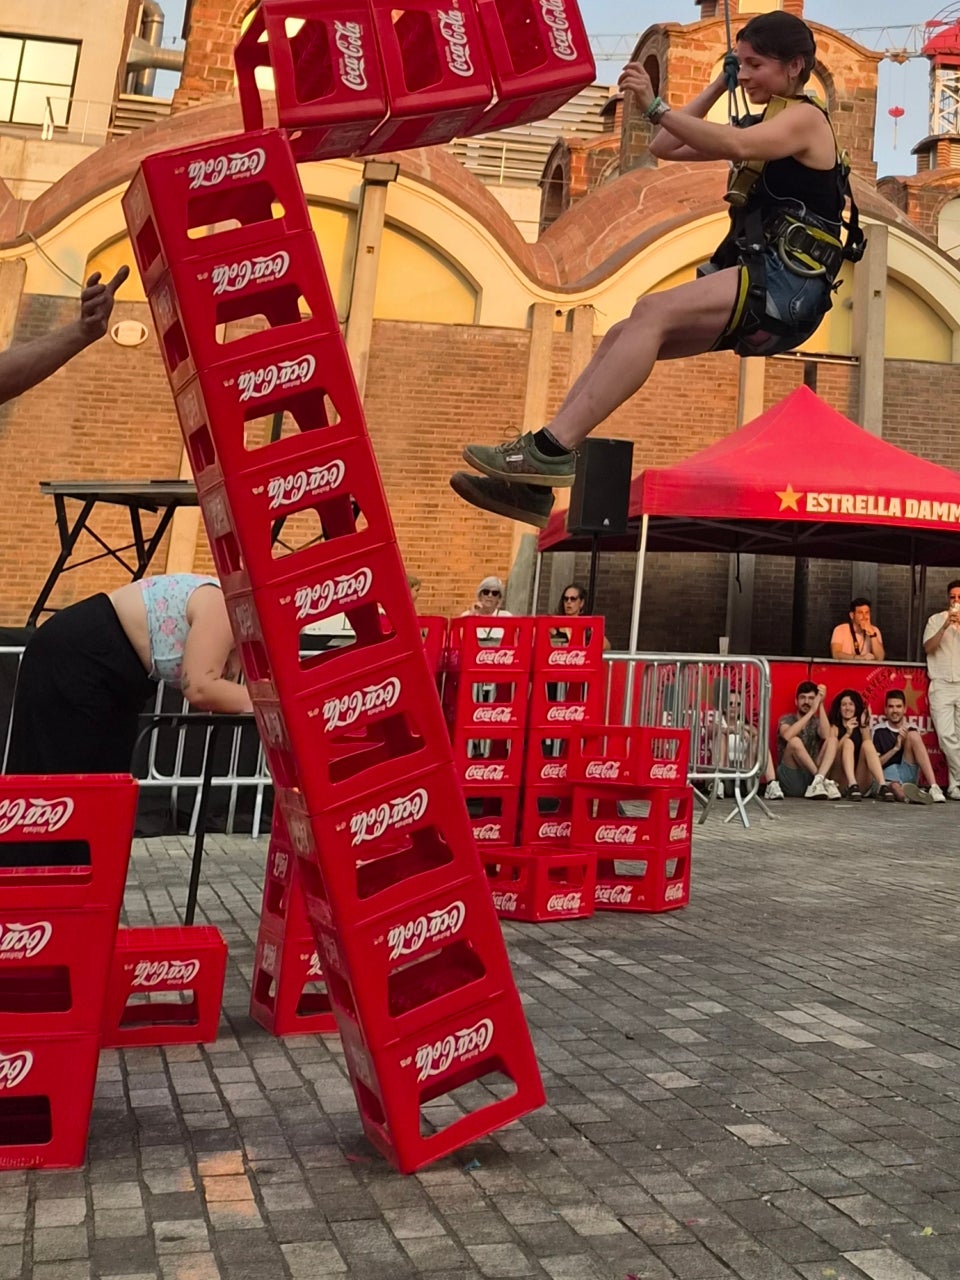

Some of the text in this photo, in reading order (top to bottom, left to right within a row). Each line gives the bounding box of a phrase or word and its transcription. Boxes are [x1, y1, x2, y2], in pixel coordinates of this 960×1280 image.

[335, 21, 367, 90] Coca-Cola
[438, 10, 473, 76] Coca-Cola
[189, 149, 265, 188] Coca-Cola
[212, 251, 289, 294] Coca-Cola
[238, 355, 315, 401] Coca-Cola
[268, 460, 344, 510] Coca-Cola
[806, 492, 902, 518] ESTRELLA
[295, 568, 372, 620] Coca-Cola
[323, 677, 400, 731] Coca-Cola
[350, 789, 427, 845] Coca-Cola
[388, 902, 465, 959] Coca-Cola
[132, 960, 199, 985] Coca-Cola
[416, 1019, 493, 1081] Coca-Cola
